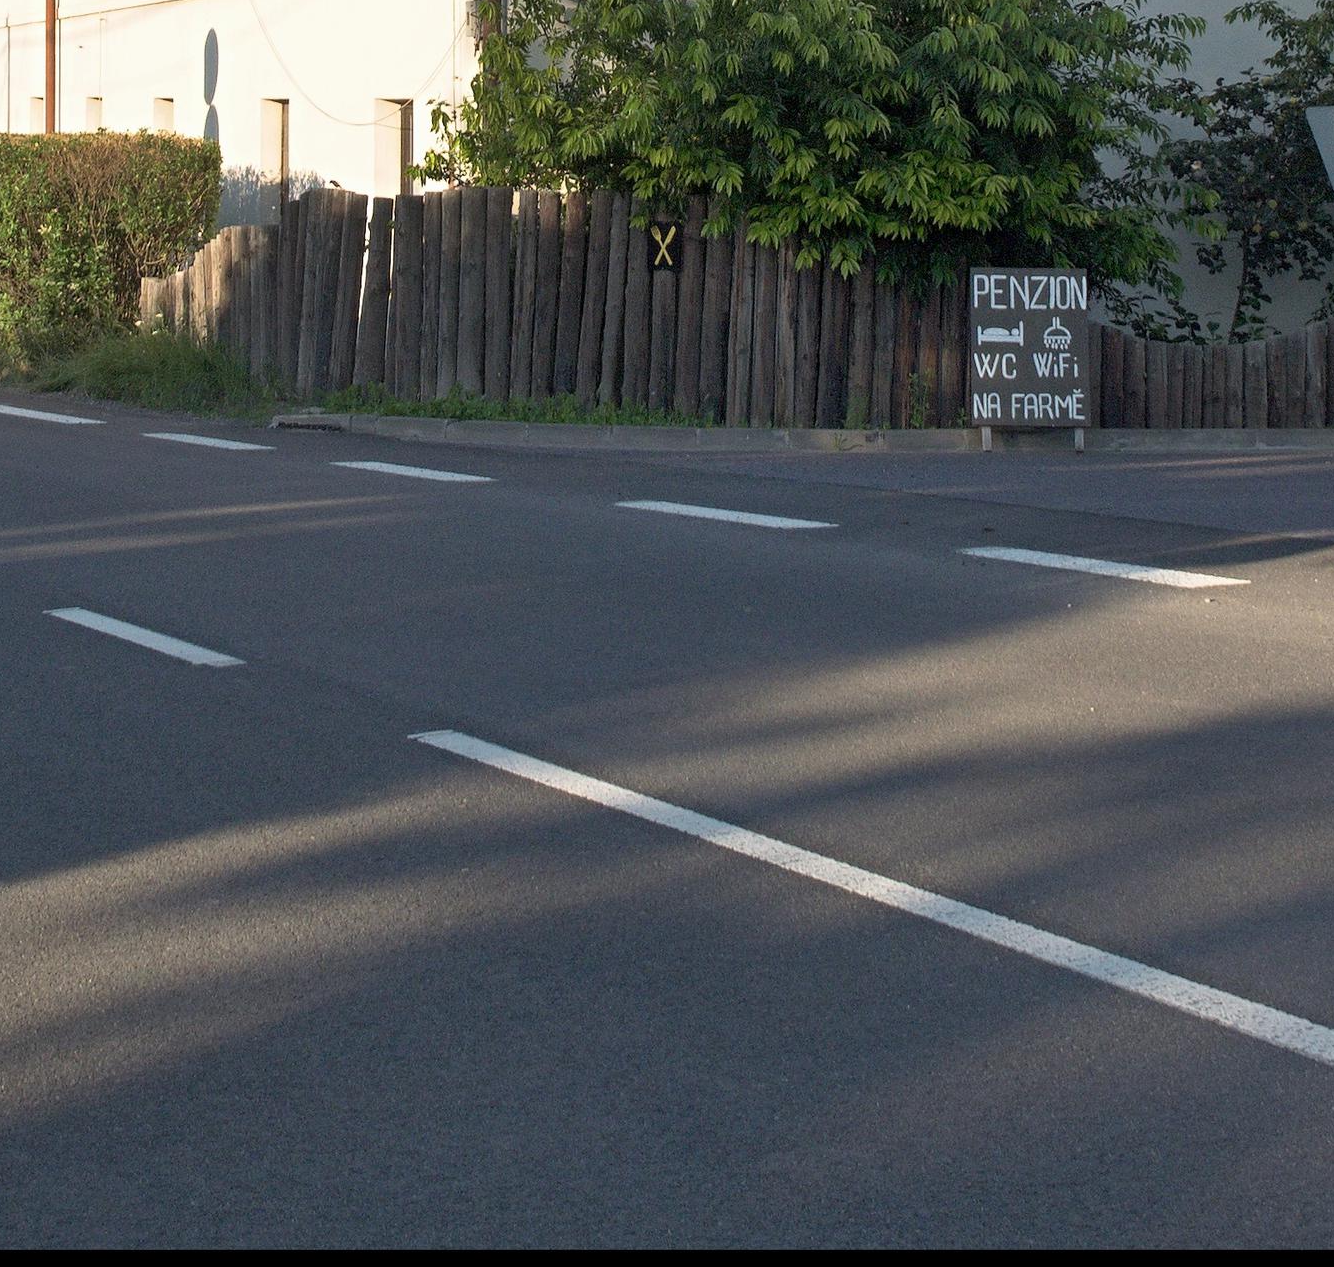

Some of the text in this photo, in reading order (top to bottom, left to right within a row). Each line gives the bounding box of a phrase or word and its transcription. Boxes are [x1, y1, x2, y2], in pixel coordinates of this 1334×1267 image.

[973, 274, 1087, 310] PENZION
[973, 352, 1016, 379] WC
[973, 388, 1086, 420] NA FARMĚ
